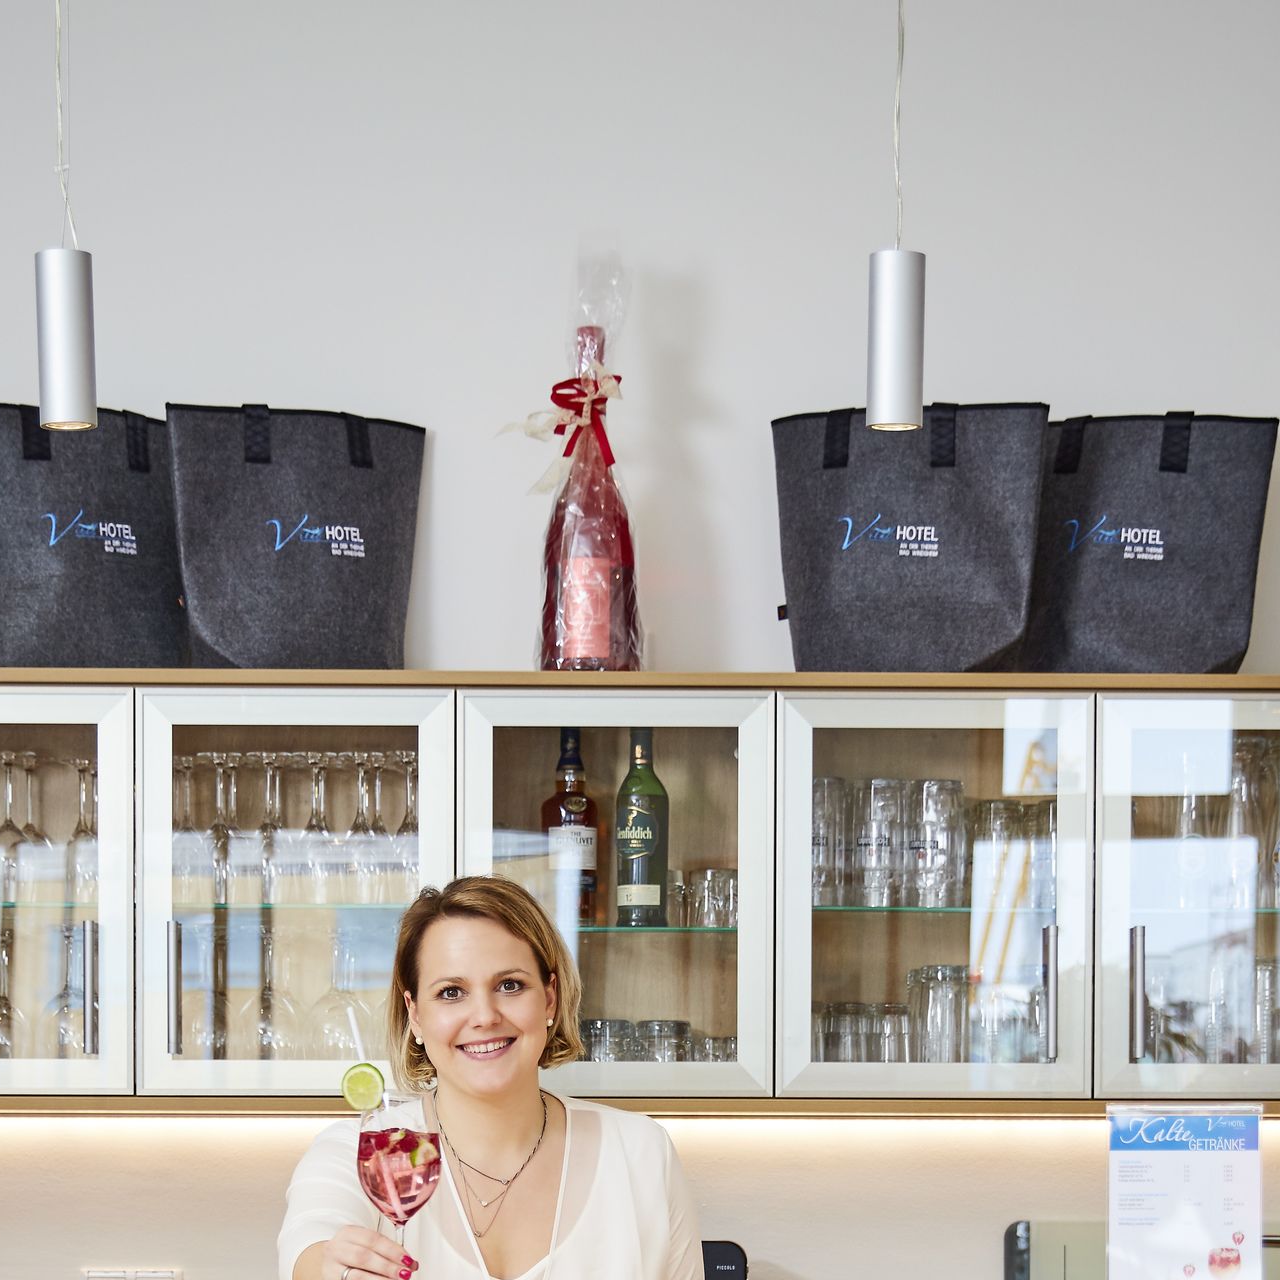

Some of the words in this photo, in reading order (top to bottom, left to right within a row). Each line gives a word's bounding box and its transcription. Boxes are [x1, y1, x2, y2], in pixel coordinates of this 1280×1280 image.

[99, 522, 136, 540] HOTEL
[325, 525, 364, 543] HOTEL
[896, 525, 939, 542] HOTEL
[1120, 527, 1164, 545] HOTEL
[617, 826, 652, 840] lenfiddich
[1119, 1116, 1194, 1144] Kalte
[1188, 1136, 1246, 1151] GETRÄNKE
